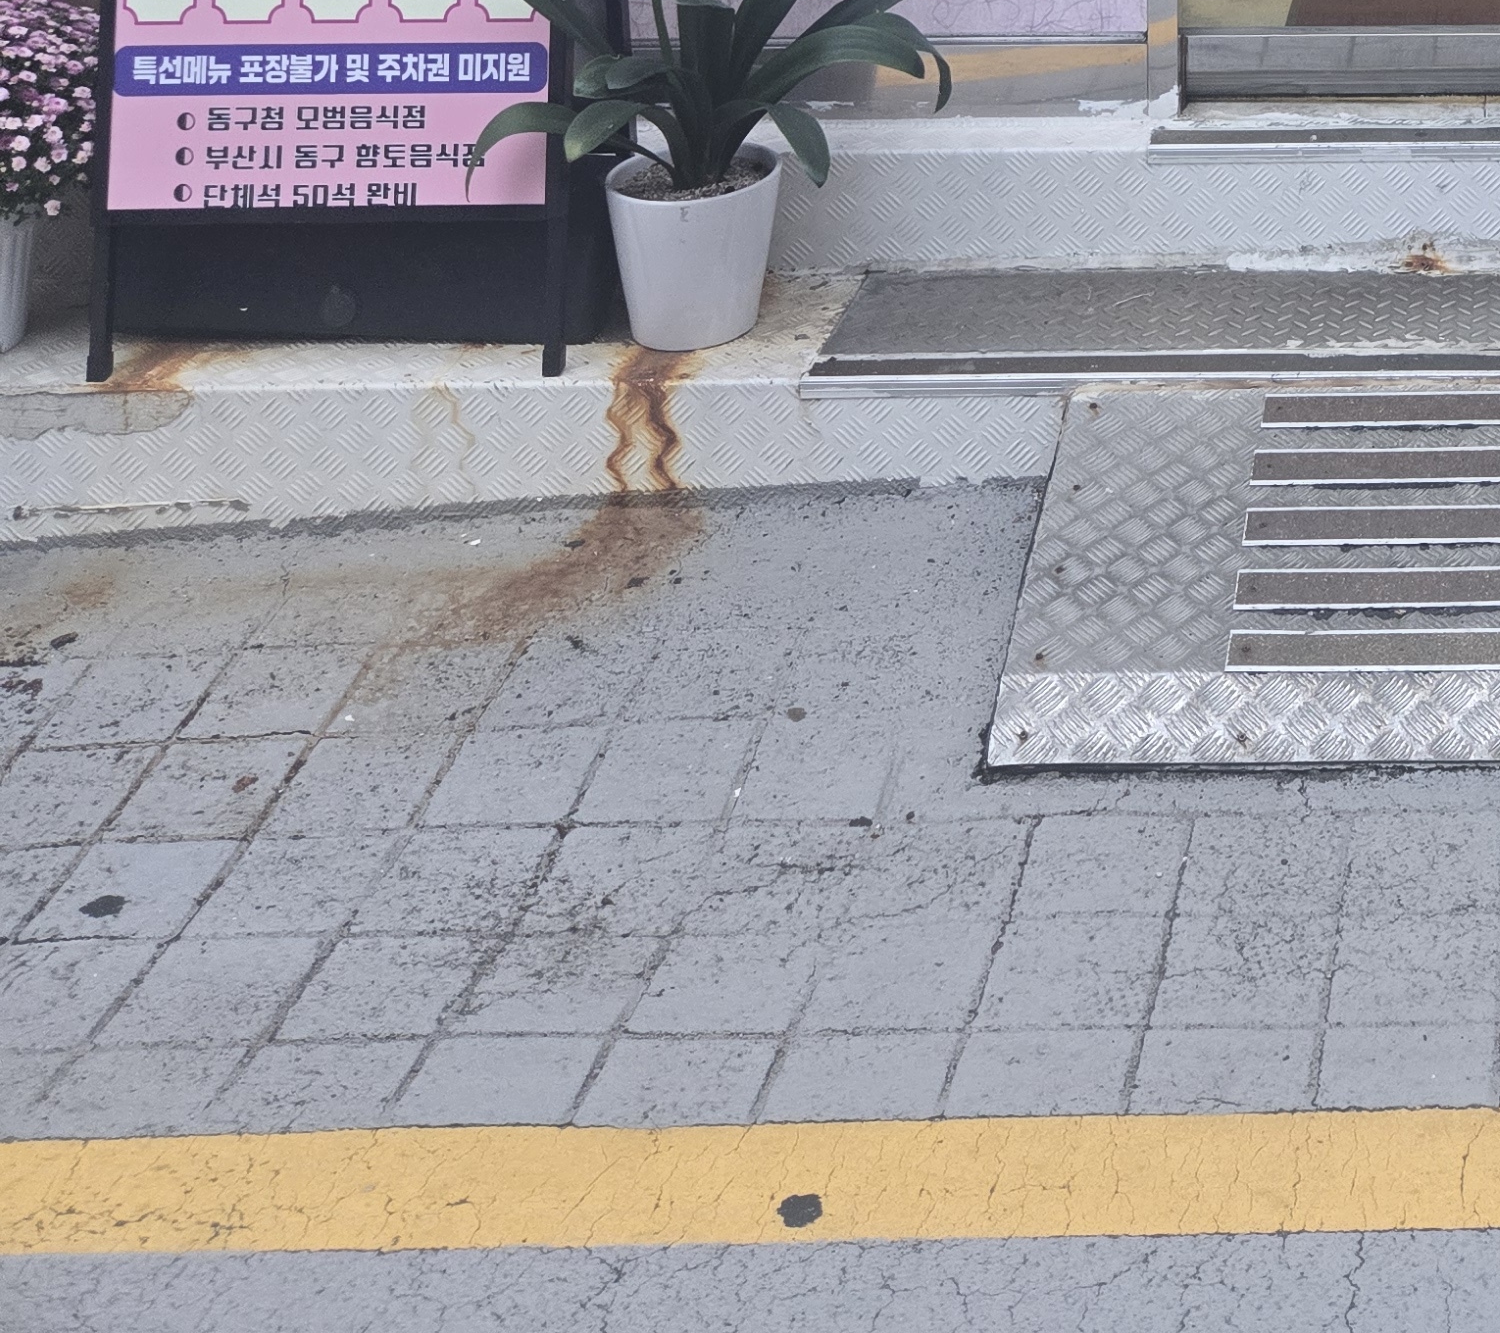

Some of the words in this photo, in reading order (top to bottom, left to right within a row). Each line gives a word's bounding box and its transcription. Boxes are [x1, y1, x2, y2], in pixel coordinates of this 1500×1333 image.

[133, 55, 232, 84] 특선메뉴
[240, 54, 339, 83] 포장불가
[347, 54, 369, 83] 및
[377, 53, 449, 82] 주차권
[459, 52, 530, 81] 미지원
[208, 106, 284, 131] 동구청
[296, 105, 426, 130] 모범음식점
[205, 145, 282, 170] 부산시
[295, 145, 344, 169] 동구
[356, 142, 485, 168] 향토음식점
[203, 184, 281, 209] 단체석
[293, 183, 356, 208] 50석
